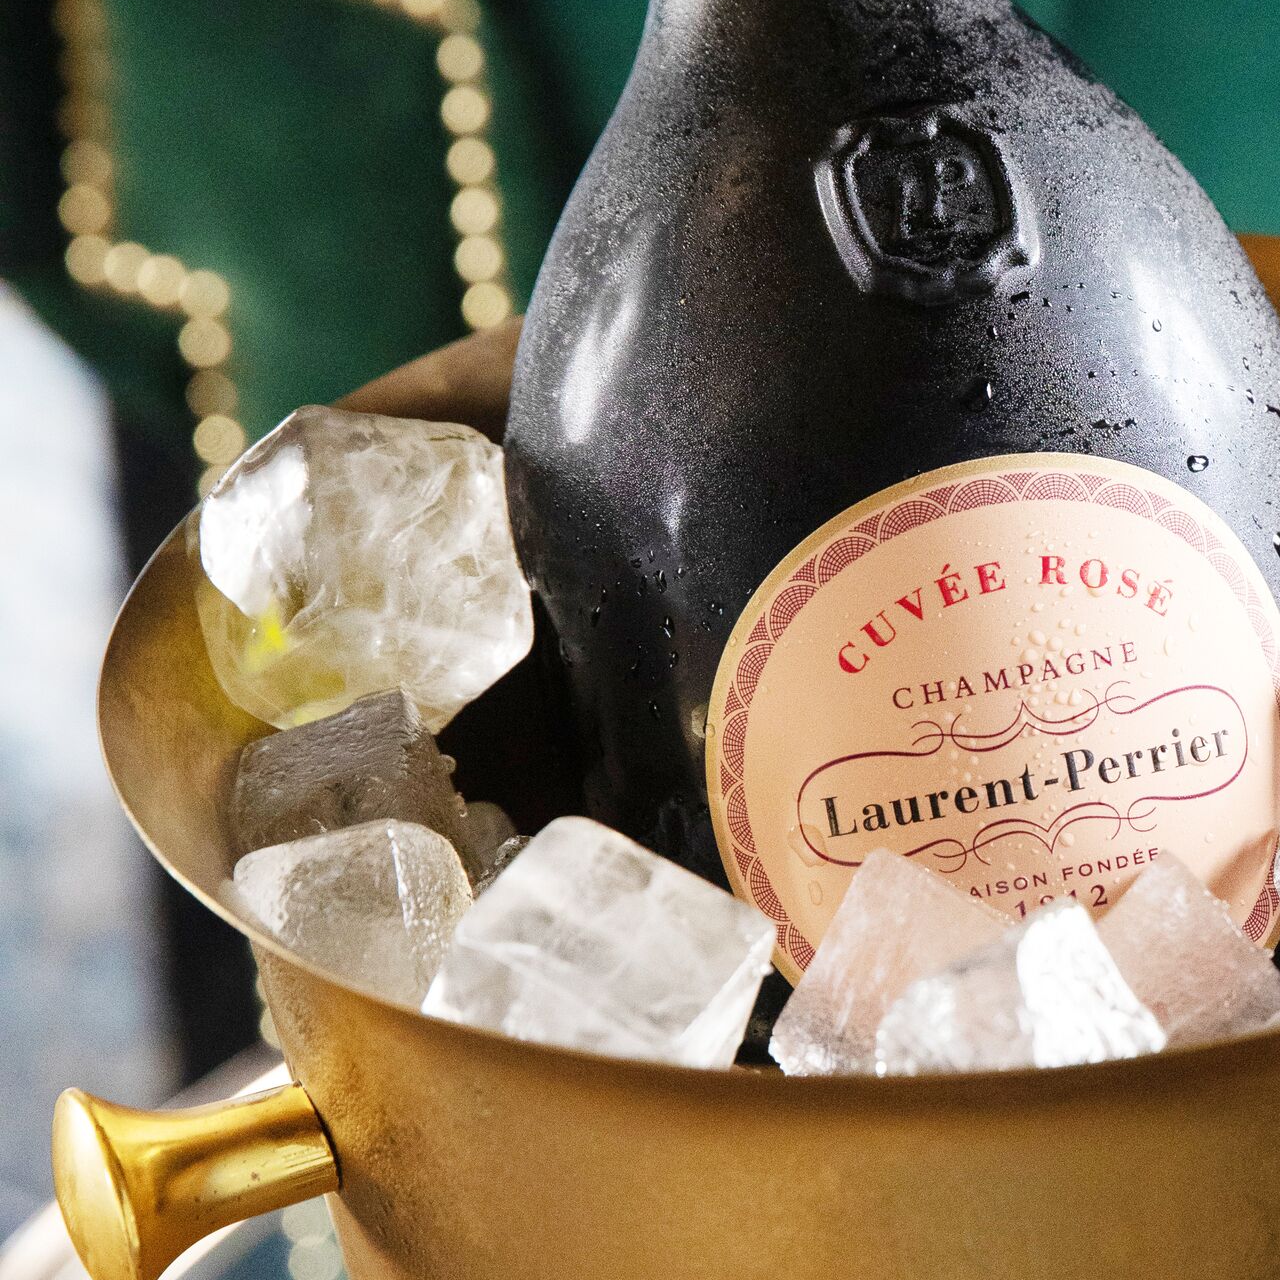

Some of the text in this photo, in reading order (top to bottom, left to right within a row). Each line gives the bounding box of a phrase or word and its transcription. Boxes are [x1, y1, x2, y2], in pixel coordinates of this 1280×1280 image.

[837, 554, 1175, 675] CUVÉE ROSÉ
[891, 640, 1139, 710] CHAMPAGNE
[820, 727, 1230, 839] Laurent-Perrier
[969, 872, 1049, 899] AISON
